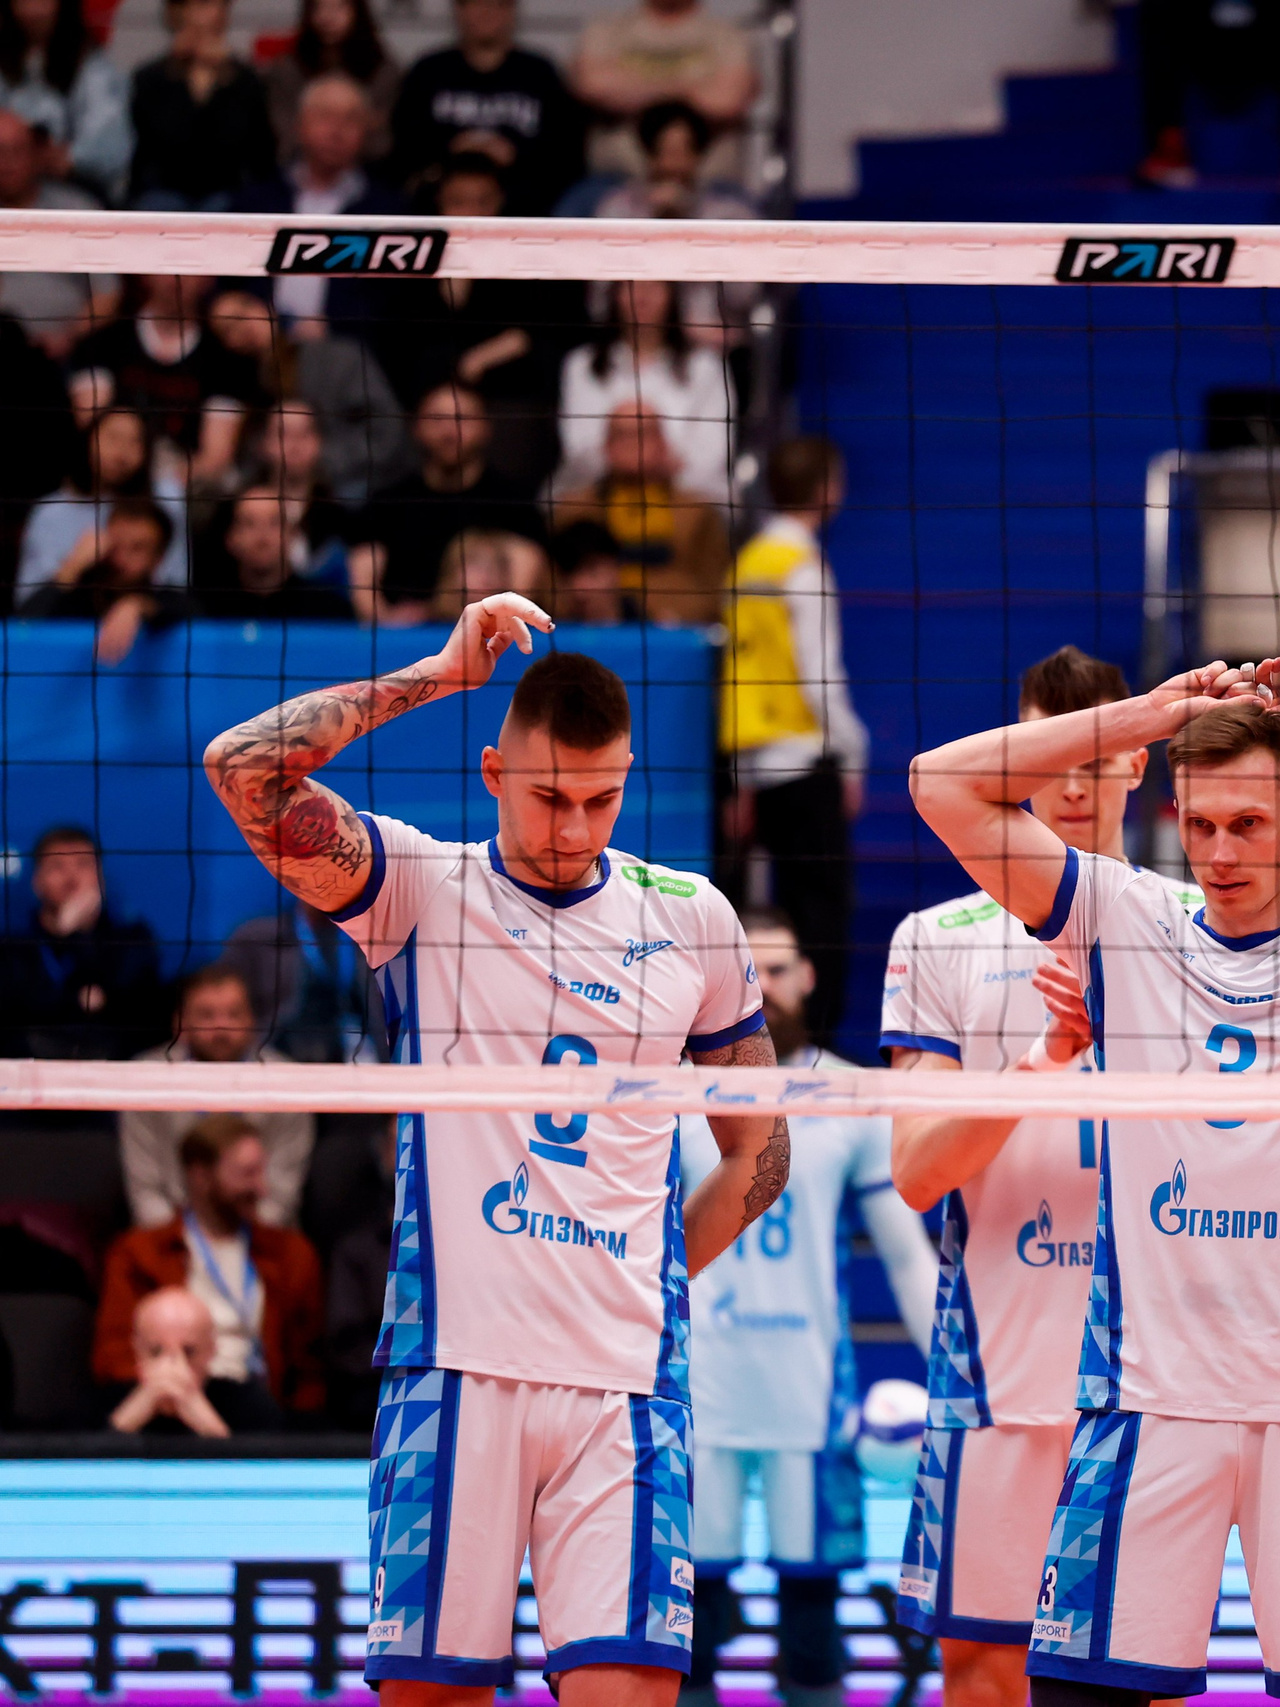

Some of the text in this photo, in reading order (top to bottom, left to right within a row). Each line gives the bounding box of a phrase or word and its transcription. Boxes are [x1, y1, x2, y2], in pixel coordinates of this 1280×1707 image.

[280, 234, 434, 271] PARI
[1069, 243, 1222, 279] PARI
[984, 969, 1033, 983] ZASPORT
[1058, 1242, 1094, 1267] ГАЗ
[374, 1566, 386, 1615] 9
[1040, 1564, 1058, 1612] 3
[1033, 1623, 1067, 1638] ASPORT
